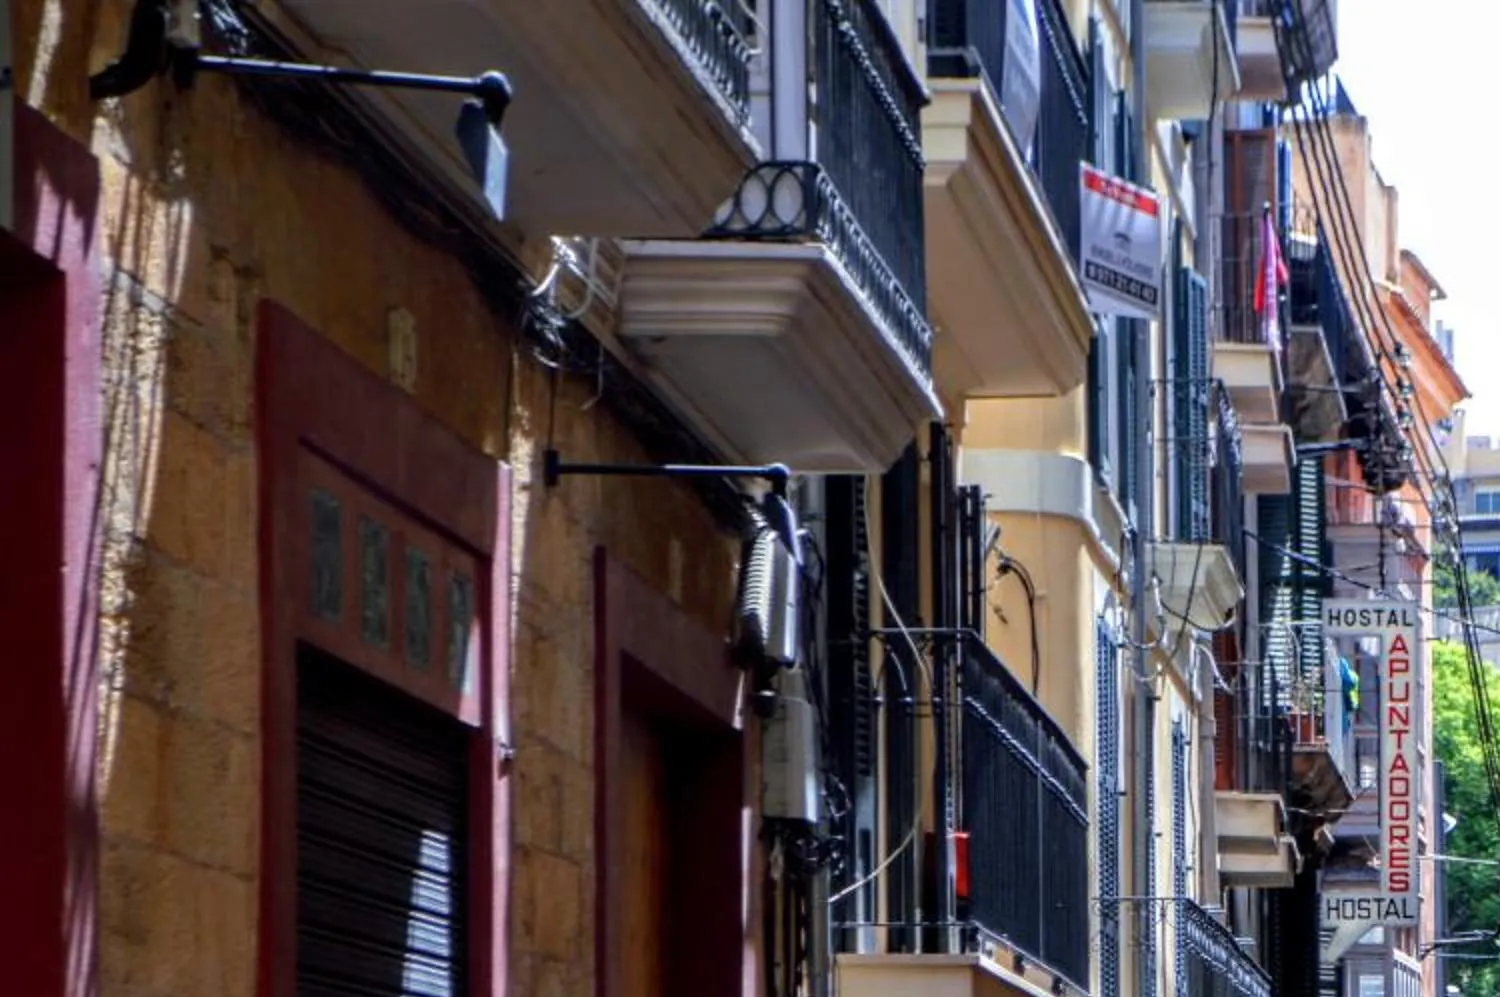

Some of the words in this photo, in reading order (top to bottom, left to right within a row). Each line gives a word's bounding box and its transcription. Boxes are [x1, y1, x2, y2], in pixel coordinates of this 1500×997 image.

[1327, 608, 1414, 628] HOSTAL
[1387, 633, 1411, 893] APUNTADORES
[1326, 896, 1415, 920] HOSTAL
